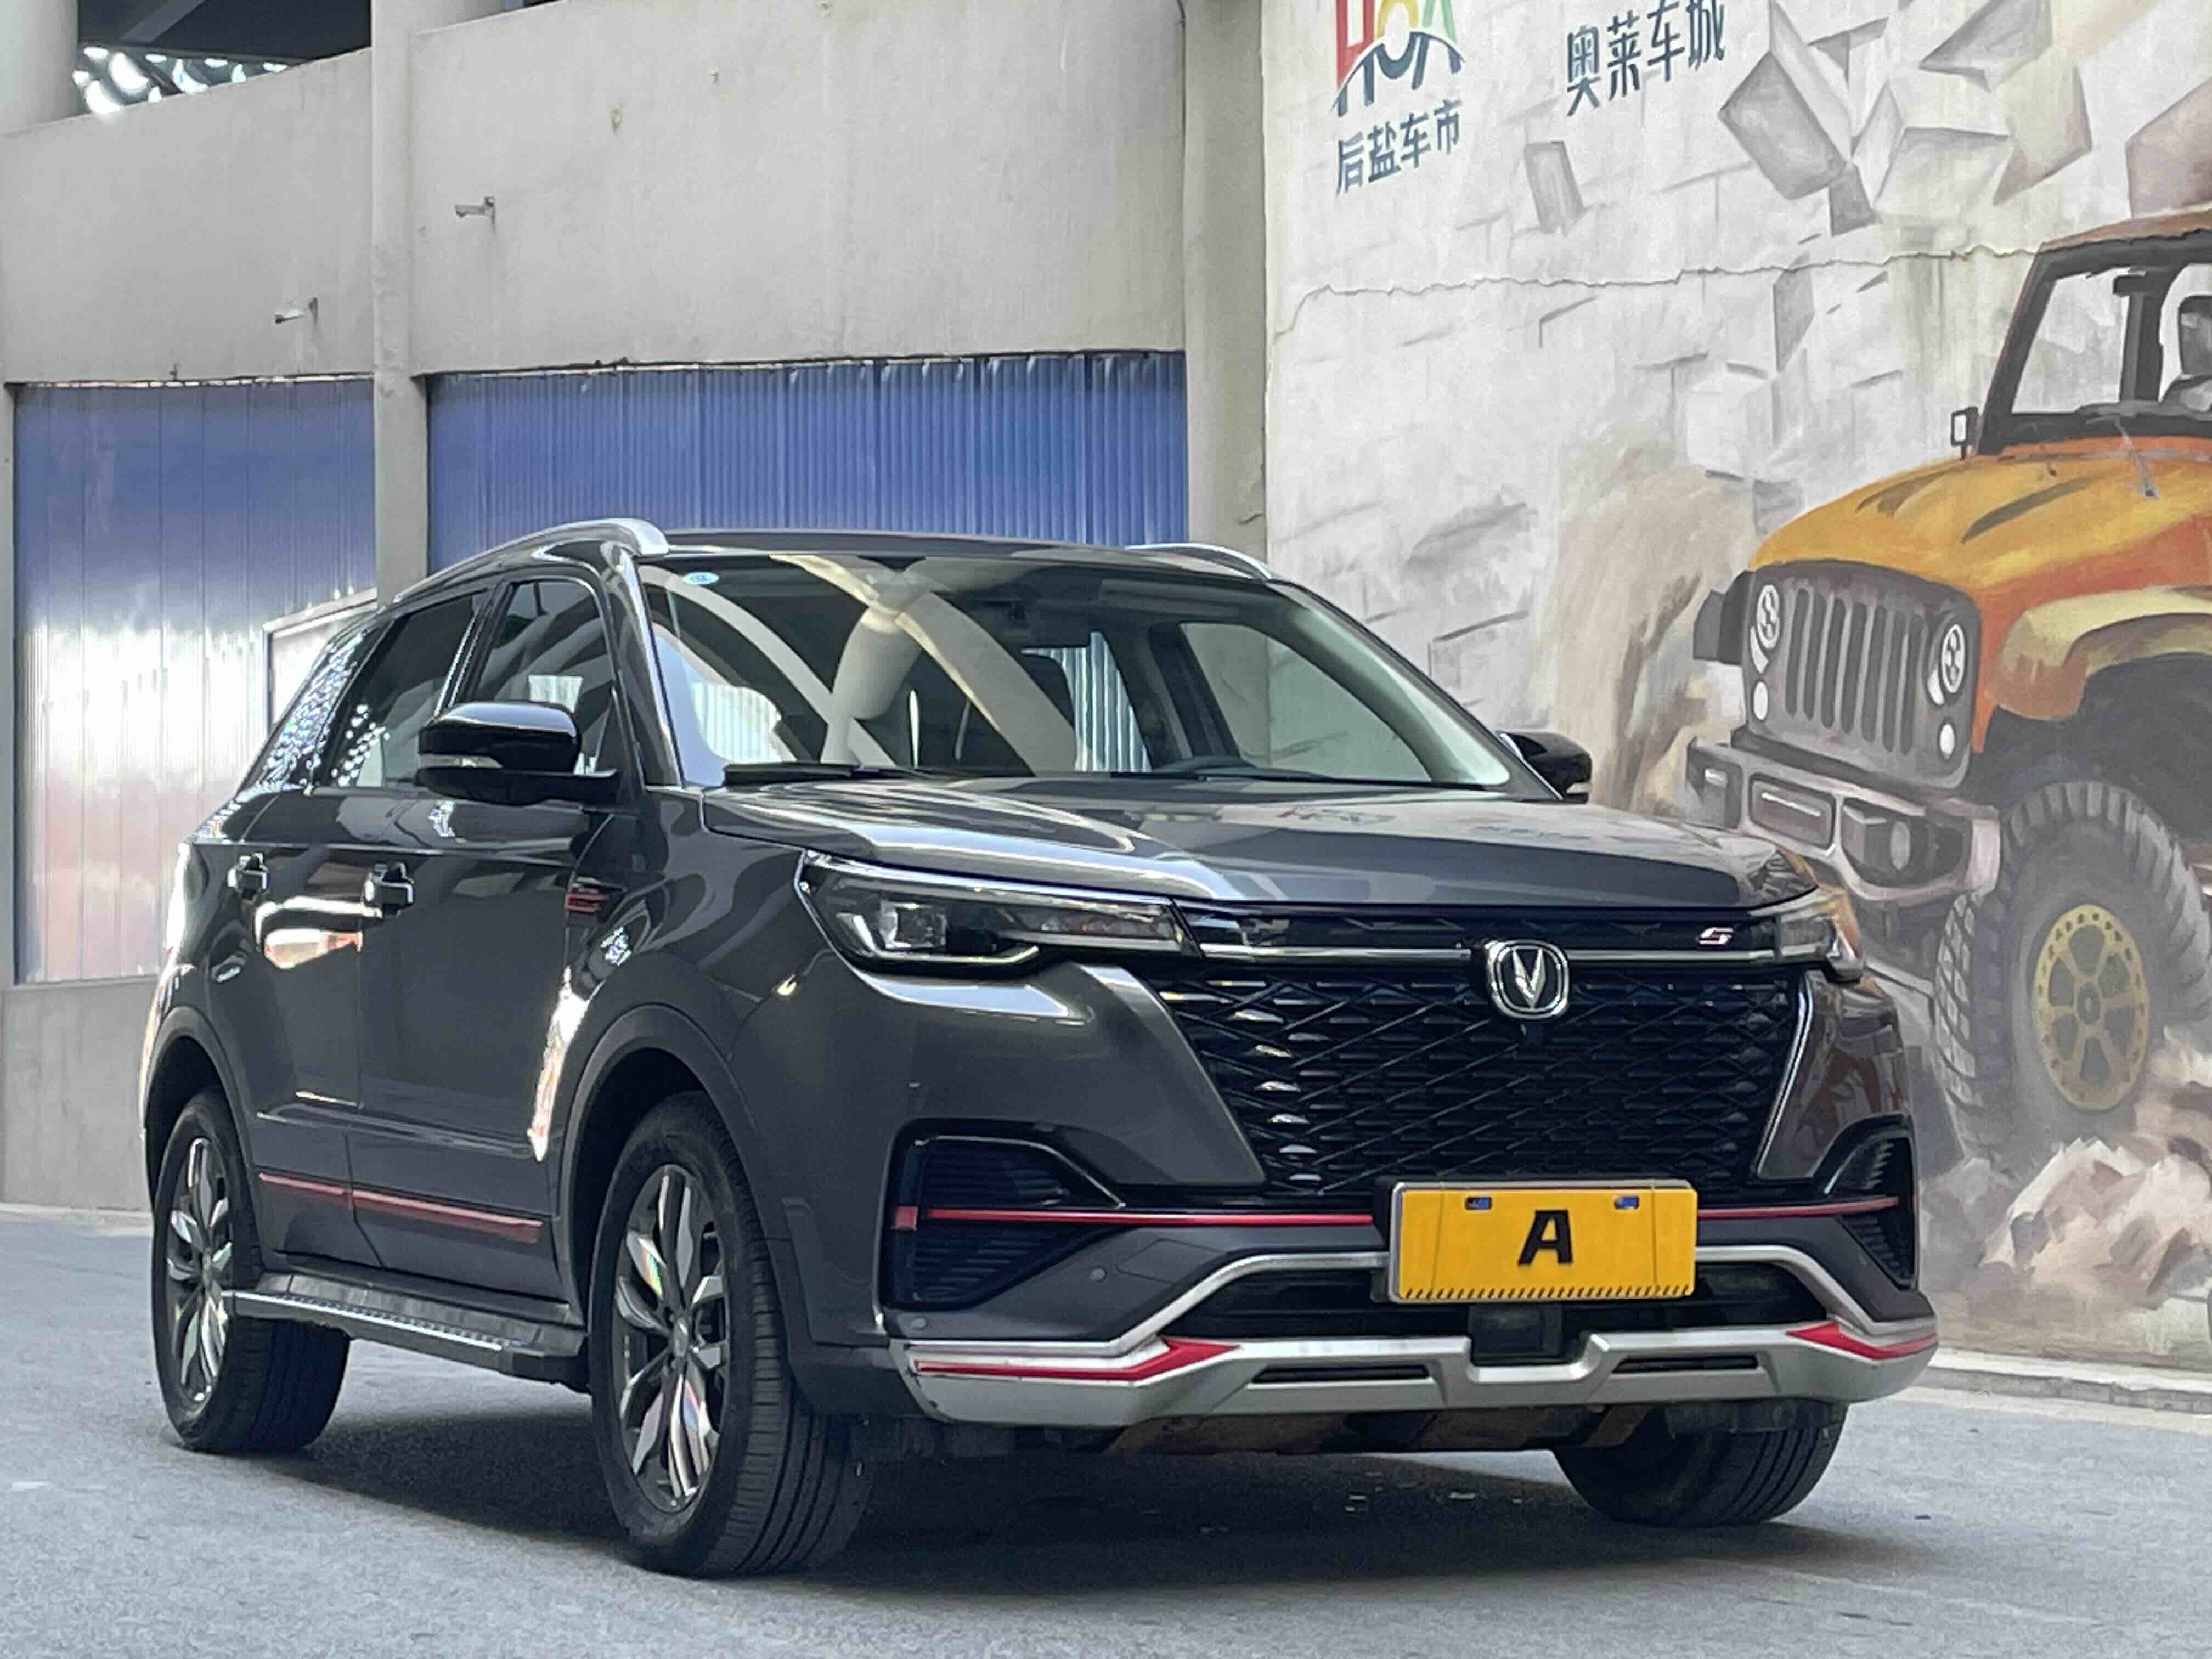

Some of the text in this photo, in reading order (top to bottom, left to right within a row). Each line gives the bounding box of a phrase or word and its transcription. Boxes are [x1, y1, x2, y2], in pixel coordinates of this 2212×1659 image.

[1566, 0, 1725, 116] 奥莱车城
[1335, 98, 1462, 197] 后盐车市
[1517, 1209, 1575, 1266] A
